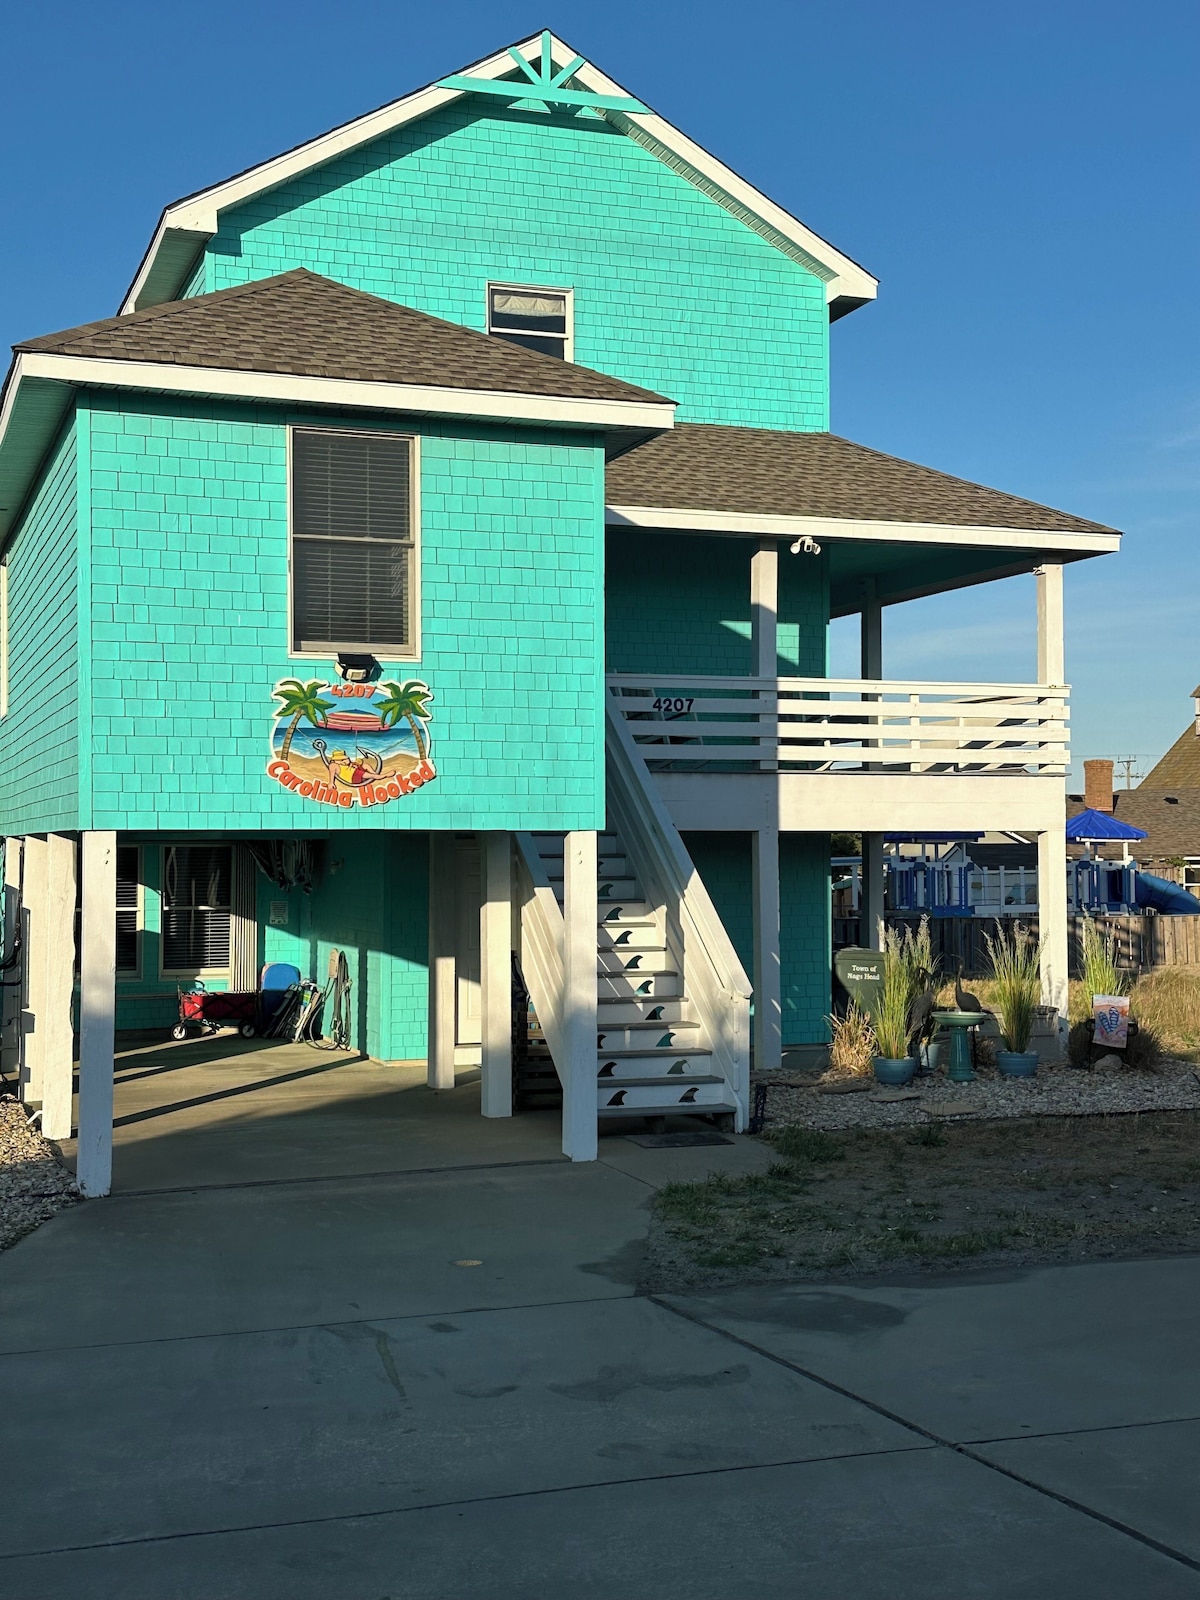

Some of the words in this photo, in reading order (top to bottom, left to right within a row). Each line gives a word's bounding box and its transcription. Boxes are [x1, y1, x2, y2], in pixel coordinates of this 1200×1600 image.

[331, 685, 376, 698] 4207
[652, 697, 694, 712] 4207
[268, 760, 353, 806] Carolina
[358, 760, 435, 805] Hooked
